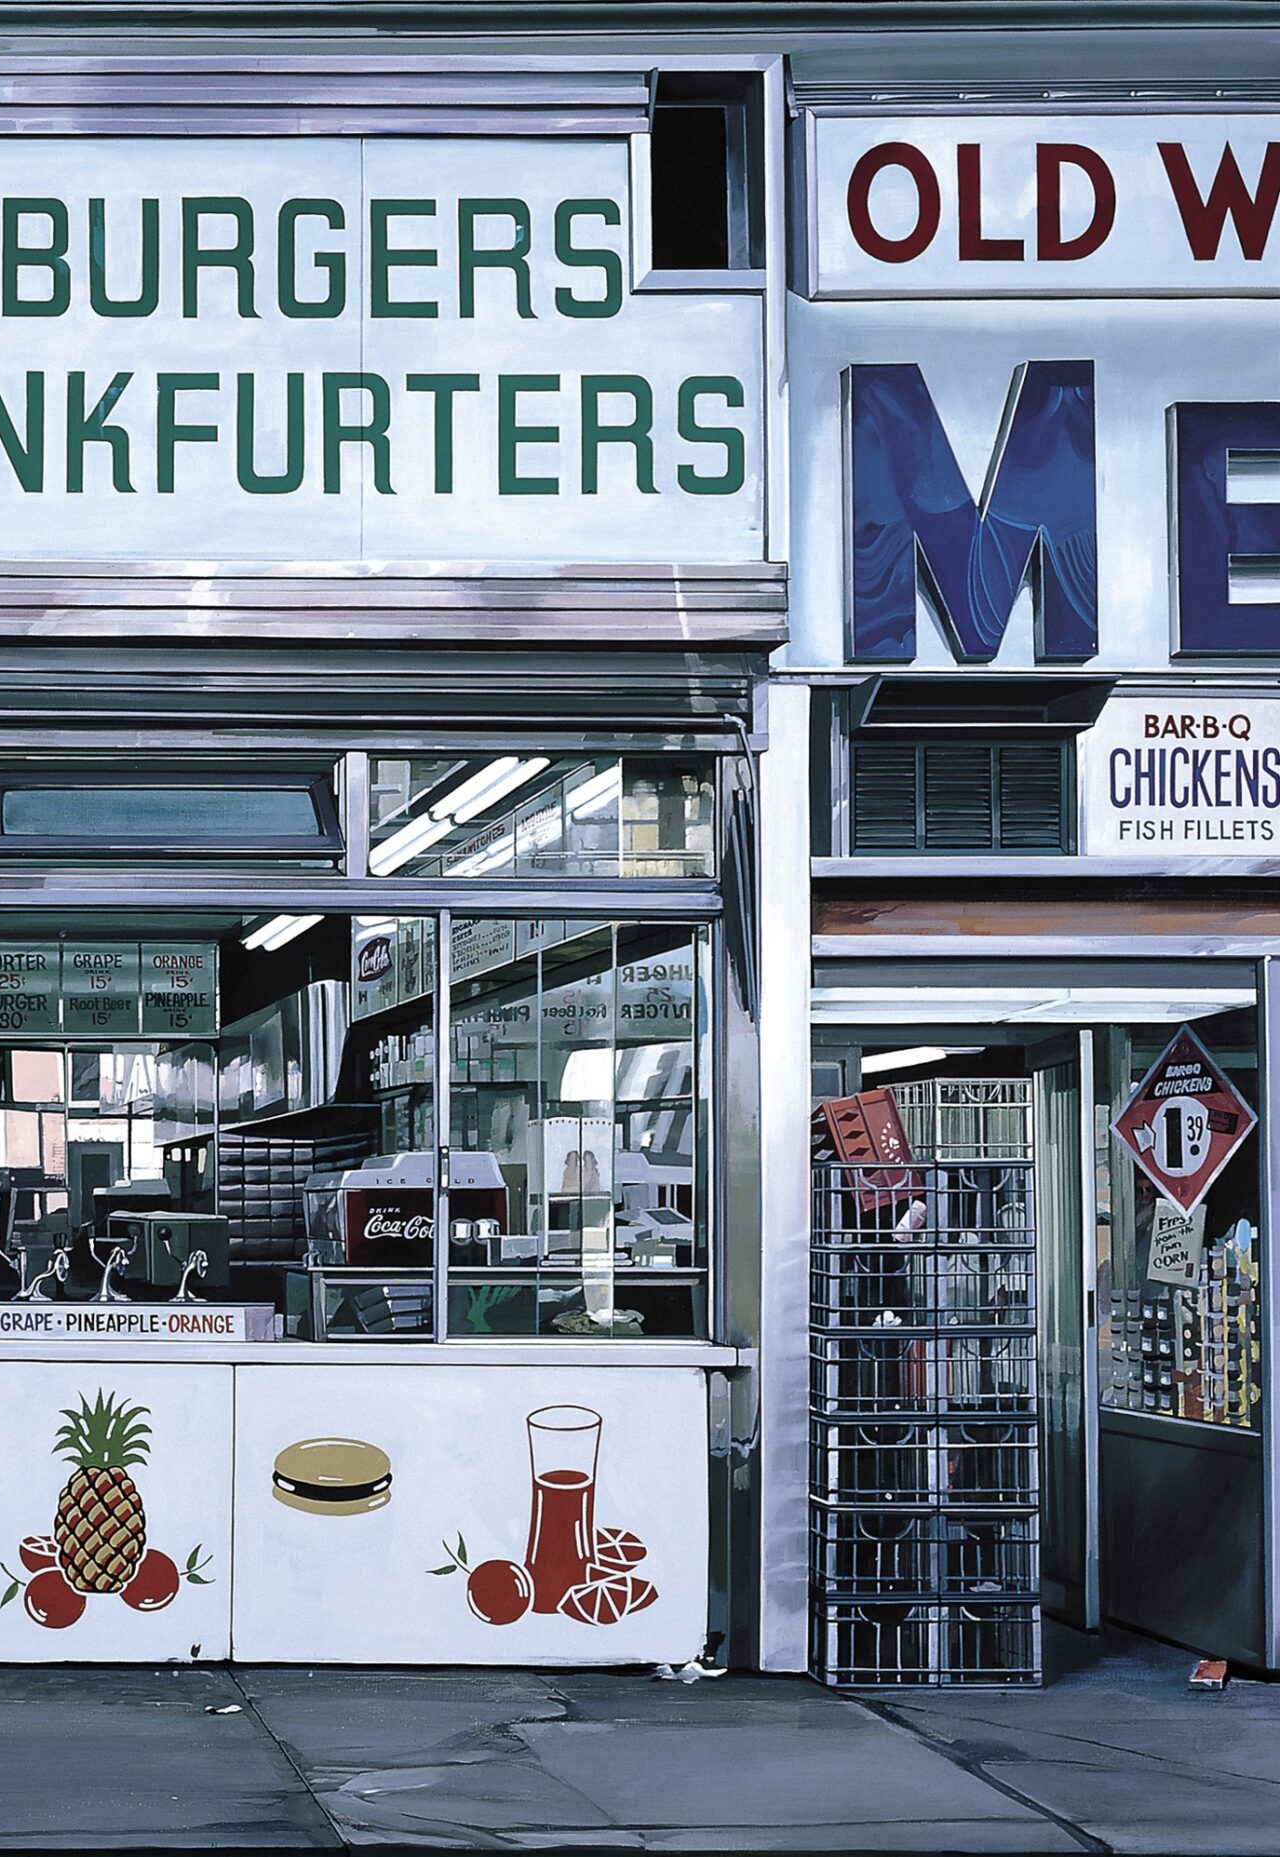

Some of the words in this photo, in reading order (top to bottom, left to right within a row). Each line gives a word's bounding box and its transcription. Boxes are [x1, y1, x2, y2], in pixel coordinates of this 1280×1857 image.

[847, 142, 1116, 263] OLD
[1110, 747, 1280, 809] CHICKENS
[1120, 820, 1173, 840] FISH
[1184, 820, 1274, 840] FILLETS
[73, 953, 123, 969] GRAPE
[152, 955, 204, 970] ORANGE
[70, 998, 100, 1011] Root
[103, 996, 133, 1011] Beer
[145, 992, 211, 1008] PINEAPPLE
[1154, 1076, 1213, 1097] CHICKENS
[425, 1177, 476, 1185] CLD
[368, 1206, 402, 1214] DRINK
[363, 1213, 435, 1240] Coca-Col
[1153, 1251, 1189, 1269] CORN
[0, 1312, 53, 1332] GRAPE
[66, 1312, 159, 1333] PINEAPPLE
[168, 1314, 235, 1334] ORANGE
